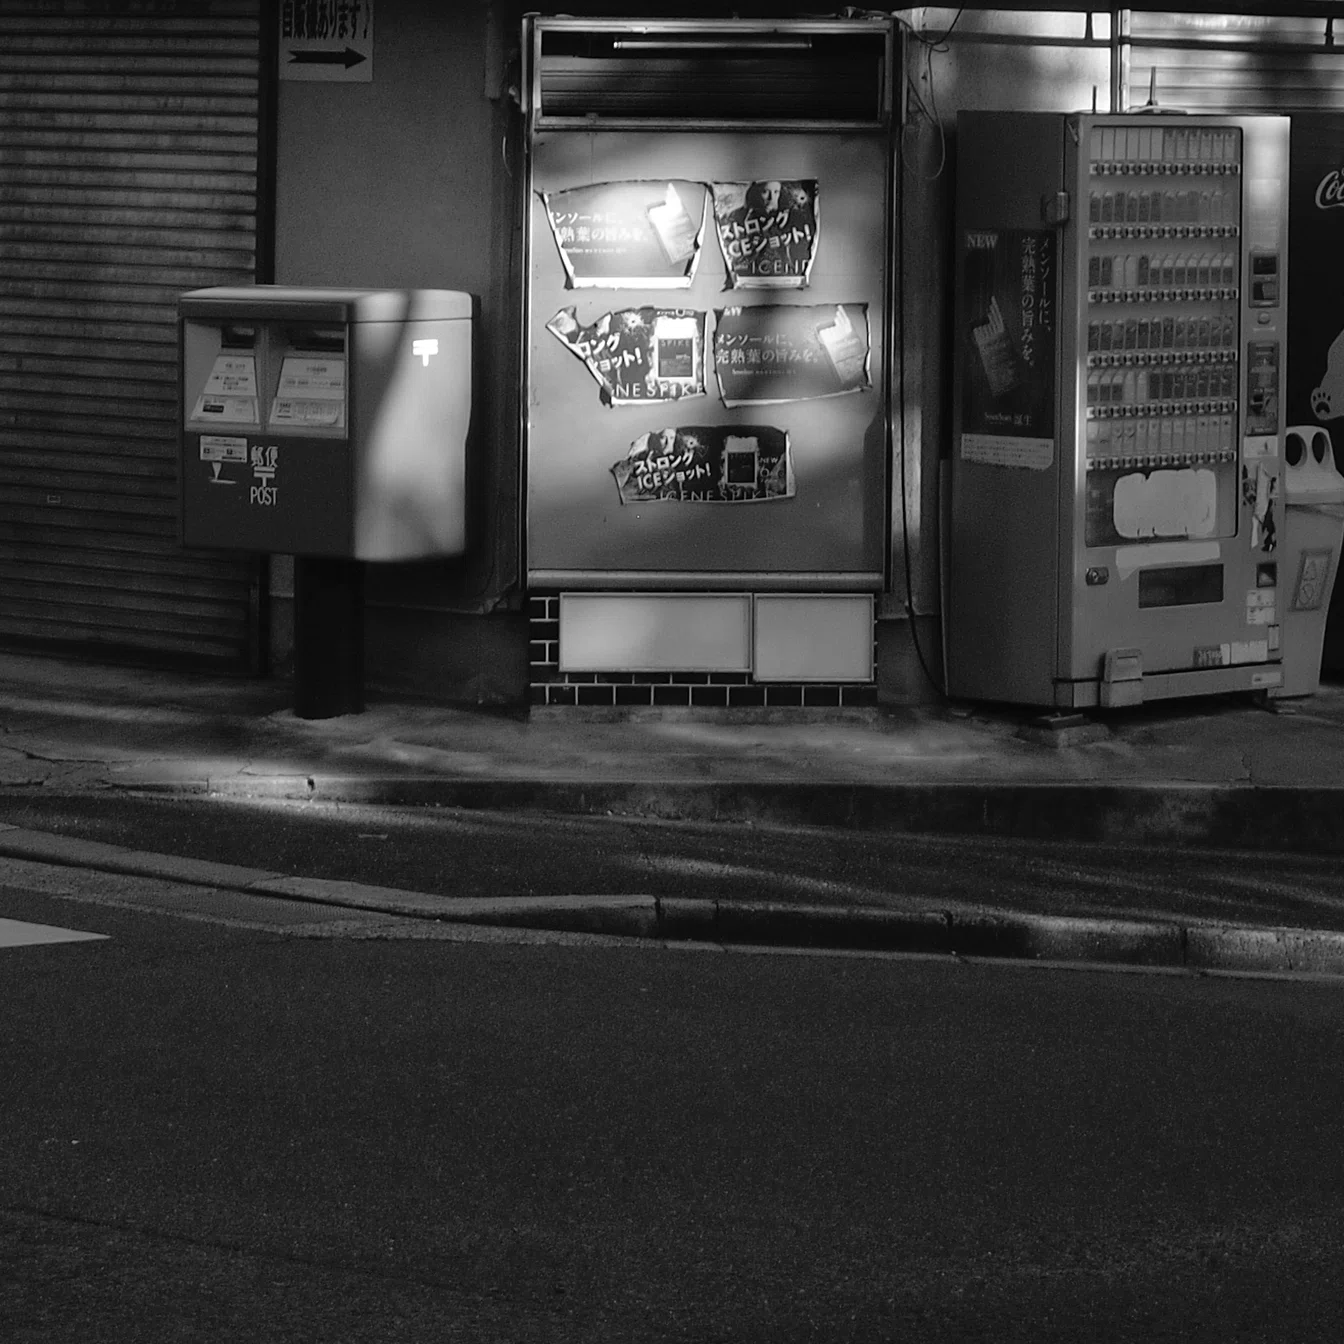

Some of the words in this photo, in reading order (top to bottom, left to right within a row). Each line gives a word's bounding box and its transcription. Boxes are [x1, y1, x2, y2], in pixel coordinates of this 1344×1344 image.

[720, 208, 790, 240] ストロング
[966, 234, 998, 250] NEW
[1021, 236, 1036, 367] 完熟葉の旨みを。
[635, 449, 696, 475] ストロング
[638, 463, 712, 490] ICEショット!
[250, 486, 278, 505] POST
